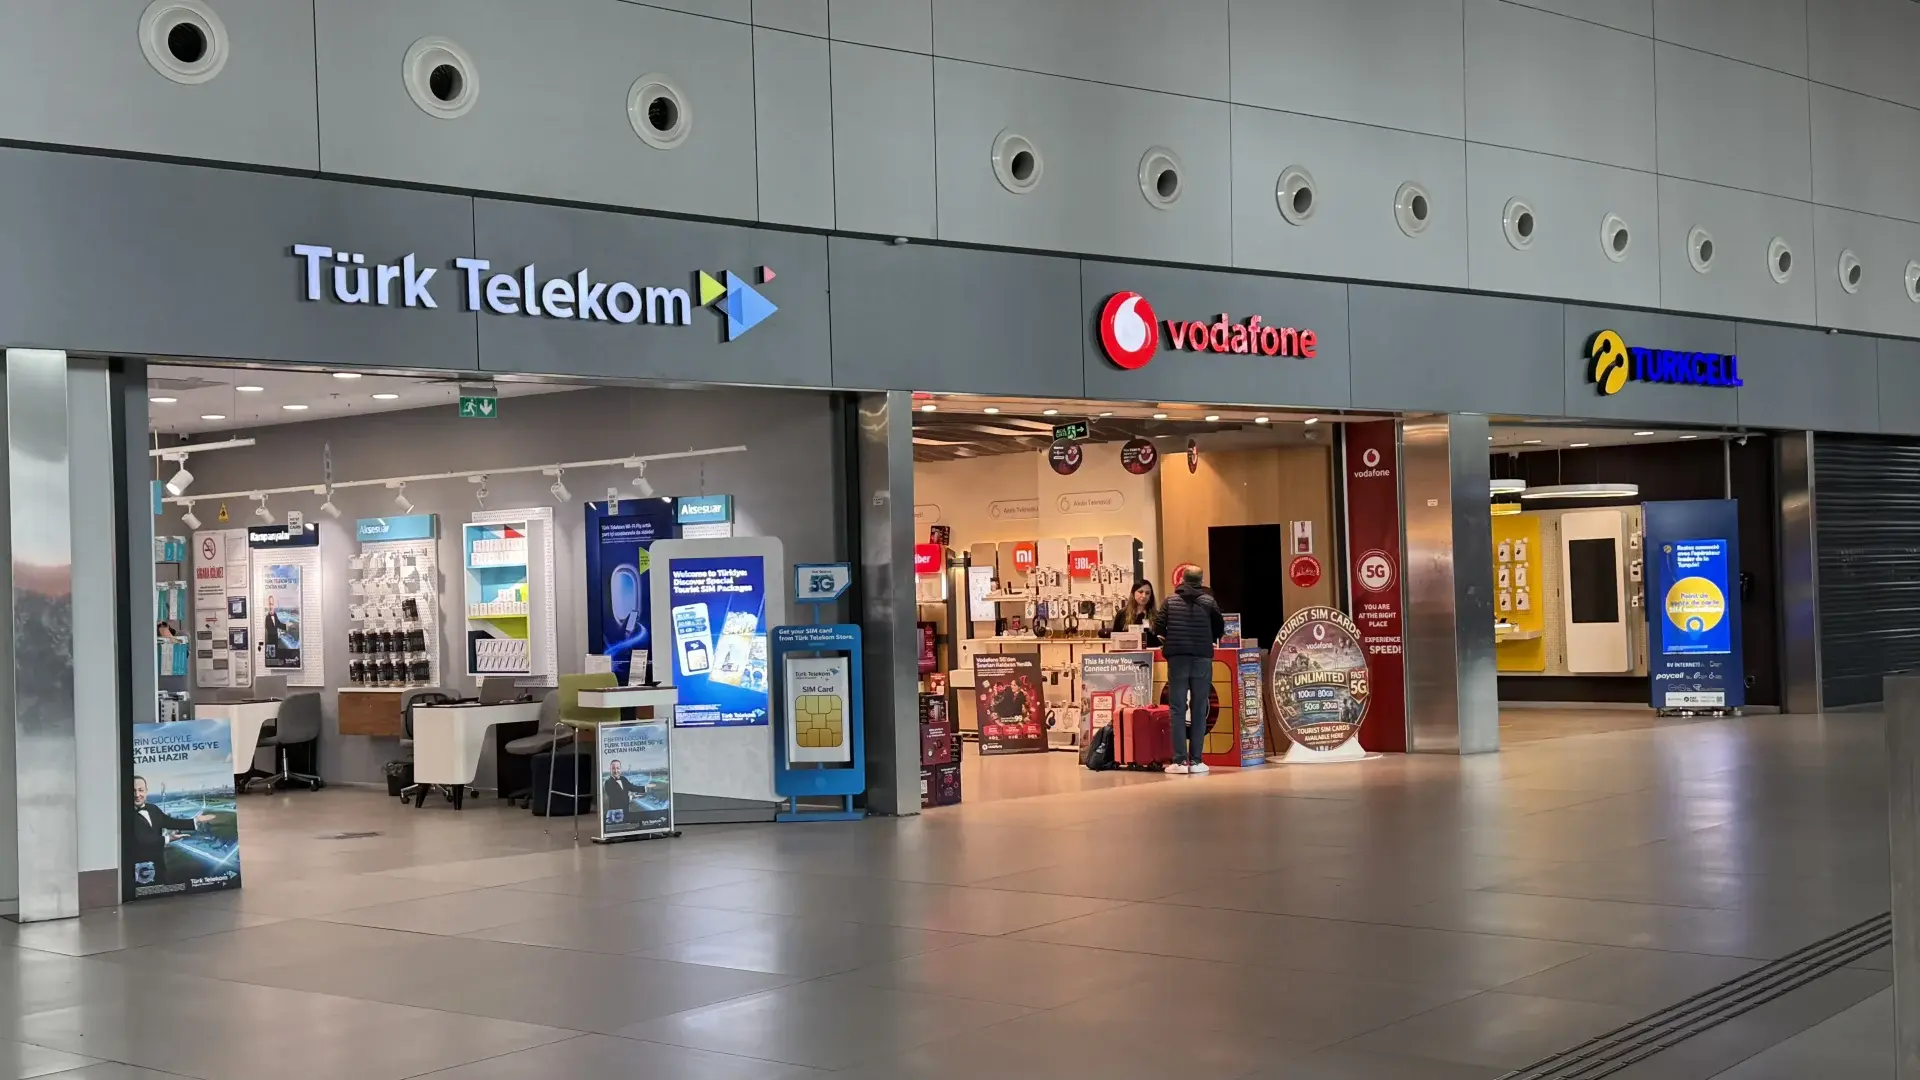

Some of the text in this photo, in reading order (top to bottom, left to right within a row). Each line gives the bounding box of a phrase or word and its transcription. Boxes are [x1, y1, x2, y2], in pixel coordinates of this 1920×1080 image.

[293, 244, 692, 326] Türk Telekom
[1164, 313, 1318, 359] vodafone
[1630, 346, 1744, 387] TURKCELL
[1354, 469, 1390, 478] vodafone
[681, 503, 722, 515] Aksesuar
[360, 524, 390, 535] Aksesuar
[915, 554, 931, 564] iber
[1074, 557, 1089, 569] JBL
[672, 570, 707, 578] Welcome
[1366, 564, 1385, 578] 5G
[673, 577, 734, 586] Discover Special
[808, 575, 835, 592] 5G
[700, 585, 716, 593] SIM
[716, 584, 753, 592] Packages
[1275, 608, 1362, 645] TOURIST SIM CARDS
[1306, 641, 1333, 650] vodafone
[1369, 645, 1402, 655] SPEED!
[1084, 664, 1110, 672] Connect
[1110, 664, 1118, 672] in
[1294, 671, 1345, 686] UNLIMITED
[1350, 670, 1365, 679] FAST
[1655, 671, 1685, 681] paycell
[817, 685, 834, 693] Card
[1350, 679, 1367, 695] 5G
[1297, 689, 1334, 699] 100GB 80GB
[1304, 701, 1338, 711] 50GB 20GB
[1297, 727, 1320, 735] TOURIST
[1331, 724, 1350, 732] CARDS
[134, 734, 193, 746] RİN GÜCÜYLE
[1304, 731, 1344, 742] AVAILABLE HERE
[133, 741, 219, 756] K TELEKOM 5G'YE
[604, 741, 620, 749] TÜRK
[620, 740, 647, 748] TELEKOM
[158, 752, 189, 762] HAZIR
[204, 875, 229, 883] Telekom
